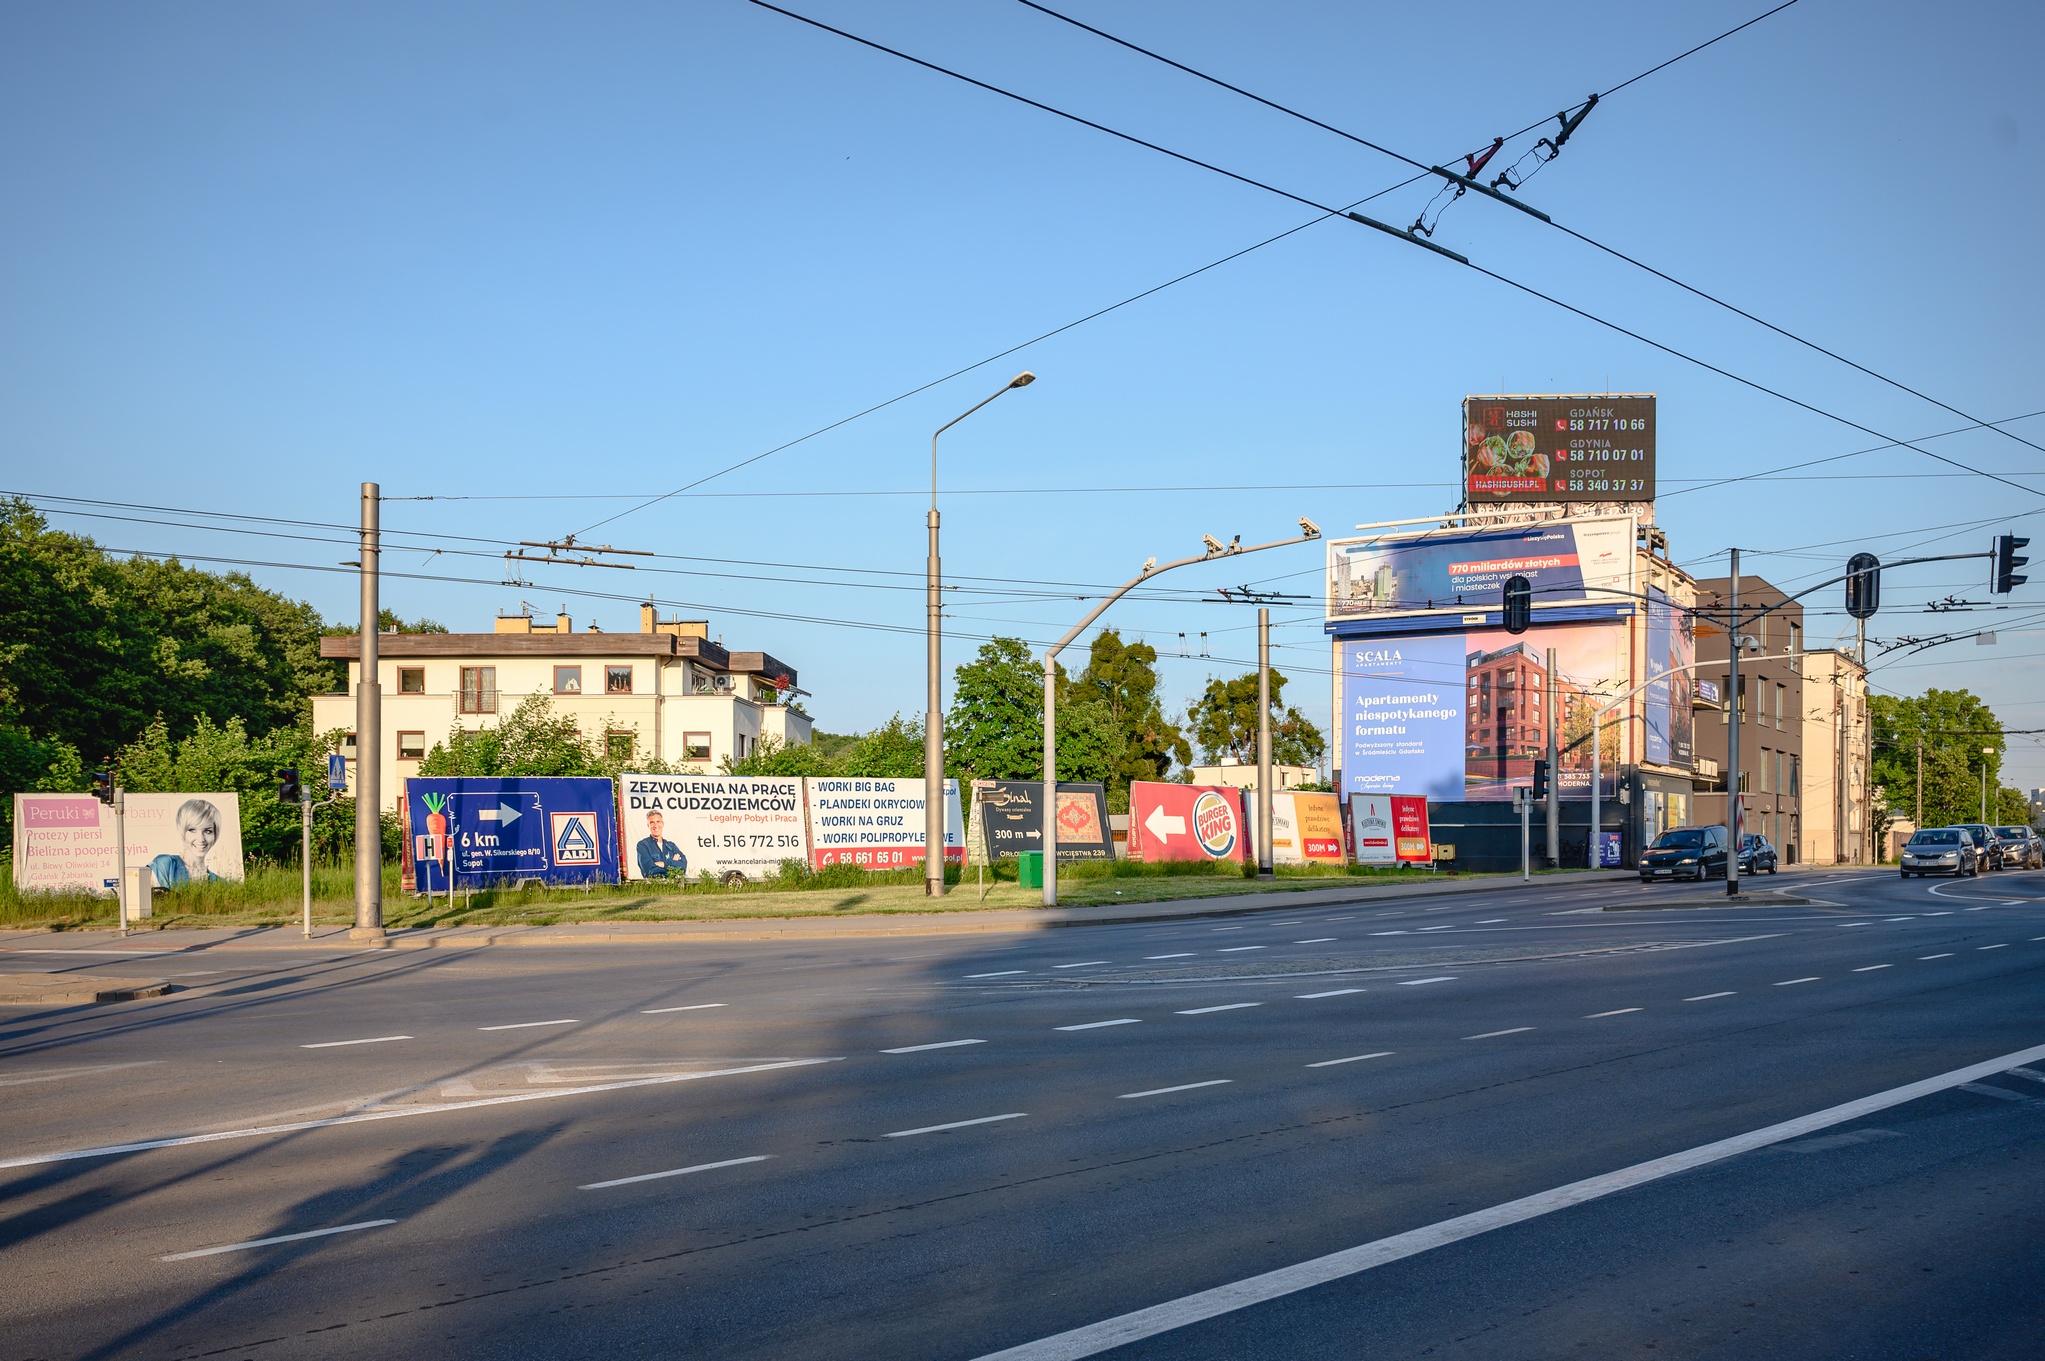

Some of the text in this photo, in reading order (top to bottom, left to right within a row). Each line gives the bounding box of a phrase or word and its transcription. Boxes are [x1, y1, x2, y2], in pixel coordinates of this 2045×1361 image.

[1570, 407, 1614, 418] GDAŃSK
[1570, 418, 1645, 430] 58 717 10 66
[1570, 439, 1611, 448] GDYNIA
[1570, 449, 1644, 461] 58 710 07 01
[1570, 469, 1606, 478] SOPOT
[1569, 480, 1644, 491] 58 340 37 37
[1575, 507, 1595, 516] 508
[1452, 557, 1560, 573] 770 miliardów złotych
[1452, 574, 1465, 584] dla
[1466, 573, 1498, 583] polskich
[1456, 581, 1500, 591] miasteczek
[1356, 650, 1402, 662] SCALA
[1355, 693, 1439, 708] Apartamenty
[1355, 708, 1457, 722] niespotykanego
[1355, 725, 1406, 736] formatu
[1362, 748, 1396, 756] Śródmieściu
[629, 781, 796, 798] ZEZWOLENIA NA PRACĘ
[818, 782, 895, 792] WORKI BIG BAG
[630, 795, 796, 811] DLA CUDZOZIEMCÓW
[820, 799, 926, 809] PLANDEKI OKRYCIOW
[30, 806, 164, 820] Peruki Trbany
[709, 813, 798, 824] Legalny Pobyt i Praca
[1198, 805, 1228, 828] BURGER
[821, 816, 904, 827] WORKI NA GRUZ
[995, 829, 1024, 839] 300 m
[1201, 815, 1232, 843] KING
[1307, 825, 1331, 834] delikatesy
[26, 829, 103, 842] Protezy piersi
[461, 831, 499, 847] 6 km
[823, 832, 954, 843] WORKI POLIPROPYLEWE
[697, 835, 799, 848] tel. 516 772 516
[1401, 843, 1415, 851] 300M
[28, 844, 148, 857] Bielizna pooperayjna
[471, 850, 484, 858] gen.
[493, 849, 527, 858] Sikorskiego
[527, 848, 541, 856] 8/10
[1307, 843, 1326, 852] 300M
[562, 850, 593, 860] ALDI
[840, 851, 903, 864] 58 661 65 01
[1000, 850, 1020, 858] ORŁO
[1056, 850, 1092, 859] WYCIĘSTWA
[43, 862, 63, 870] Bitwy
[65, 861, 98, 869] Oliwskiej
[100, 860, 110, 868] 34
[462, 859, 483, 868] Sopot
[31, 871, 93, 880] Gdańsk Żabianka
